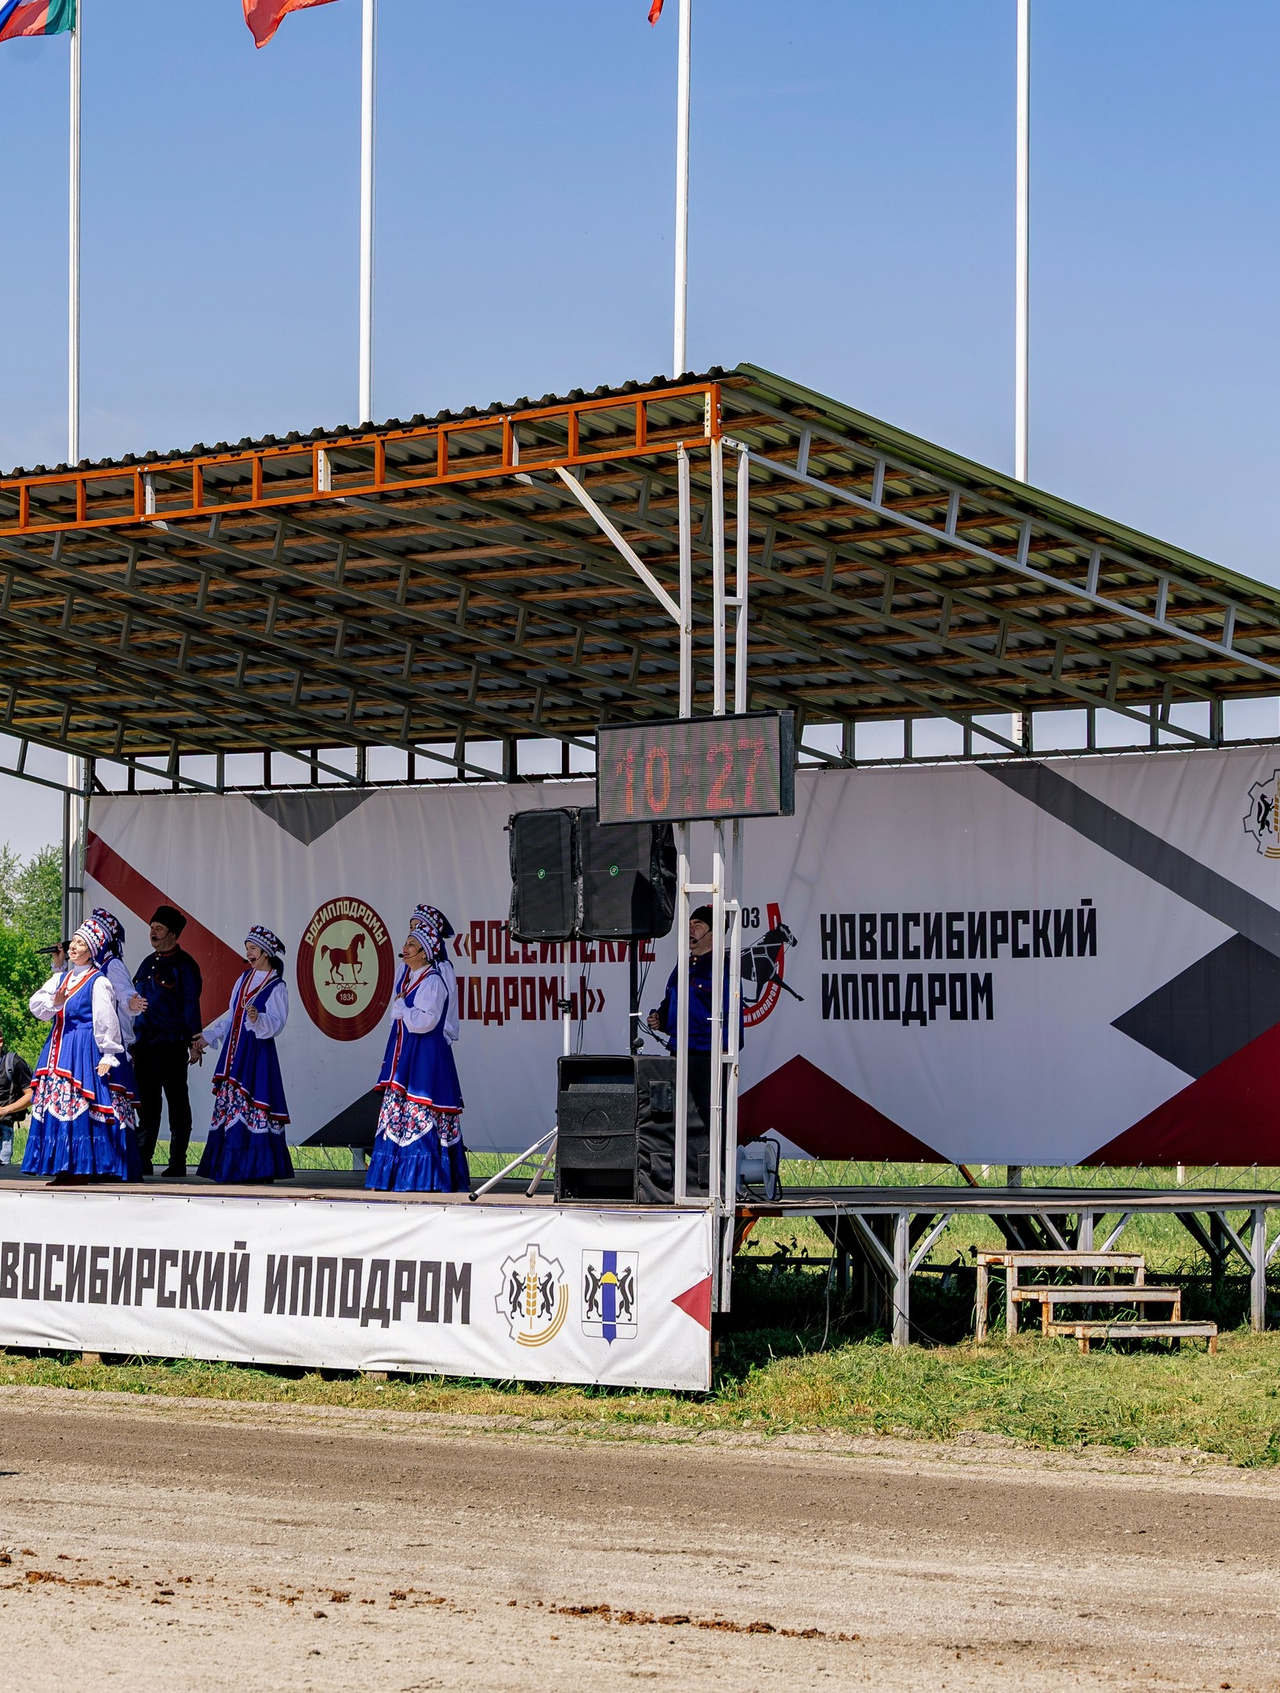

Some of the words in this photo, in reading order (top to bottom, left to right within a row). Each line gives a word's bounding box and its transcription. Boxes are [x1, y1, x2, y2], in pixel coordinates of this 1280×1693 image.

[616, 737, 765, 815] 10:27
[304, 900, 388, 947] РОСИППОДРОМЫ
[820, 898, 1097, 960] НОВОСИБИРСКИЙ
[339, 993, 354, 1001] 1834
[821, 972, 994, 1026] ИППОДРОМ
[264, 1254, 472, 1328] ИППОДРОМ
